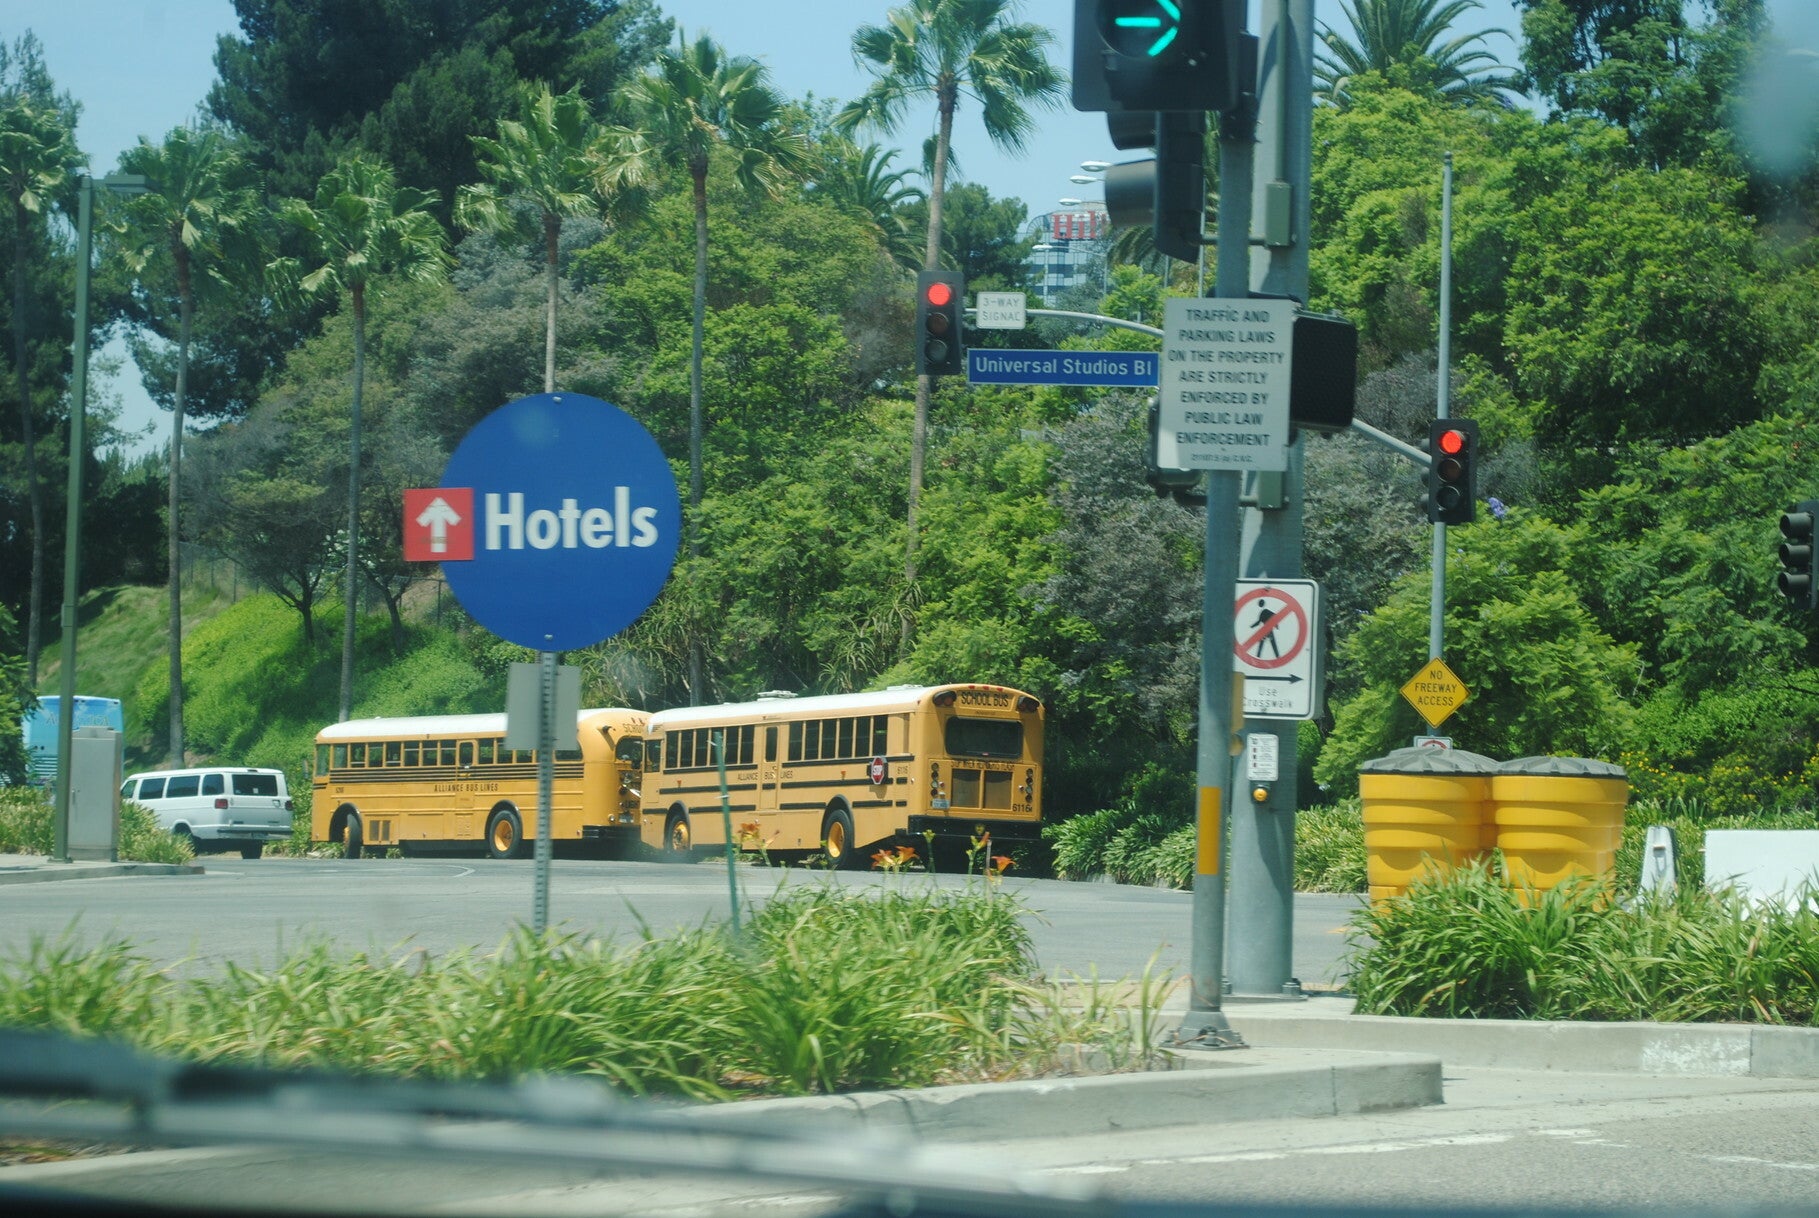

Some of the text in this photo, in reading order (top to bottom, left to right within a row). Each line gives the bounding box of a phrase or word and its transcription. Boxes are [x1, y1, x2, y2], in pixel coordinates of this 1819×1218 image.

[982, 311, 1021, 321] SIGNAL
[1186, 308, 1270, 323] TRAFFIC AND
[1178, 329, 1275, 343] PARKING LAWS
[1167, 350, 1285, 364] ON THE PROPERTY
[975, 357, 1057, 374] Universal
[1063, 358, 1128, 375] Studios
[1178, 370, 1269, 384] ARE STRICTLY
[1180, 391, 1269, 405] ENFORCED BY
[1184, 411, 1263, 426] PUBLIC LAW
[1176, 432, 1270, 446] ENFORCEMENT
[485, 486, 658, 550] Hotels
[1429, 670, 1443, 680] NO
[1414, 682, 1457, 693] FREEWAY
[960, 691, 1009, 707] SCHOOL BUS
[1417, 696, 1454, 706] ACCESS
[737, 770, 793, 781] ALLIANCE BUS LINES
[434, 783, 498, 792] ALLIANCE BUS LINES
